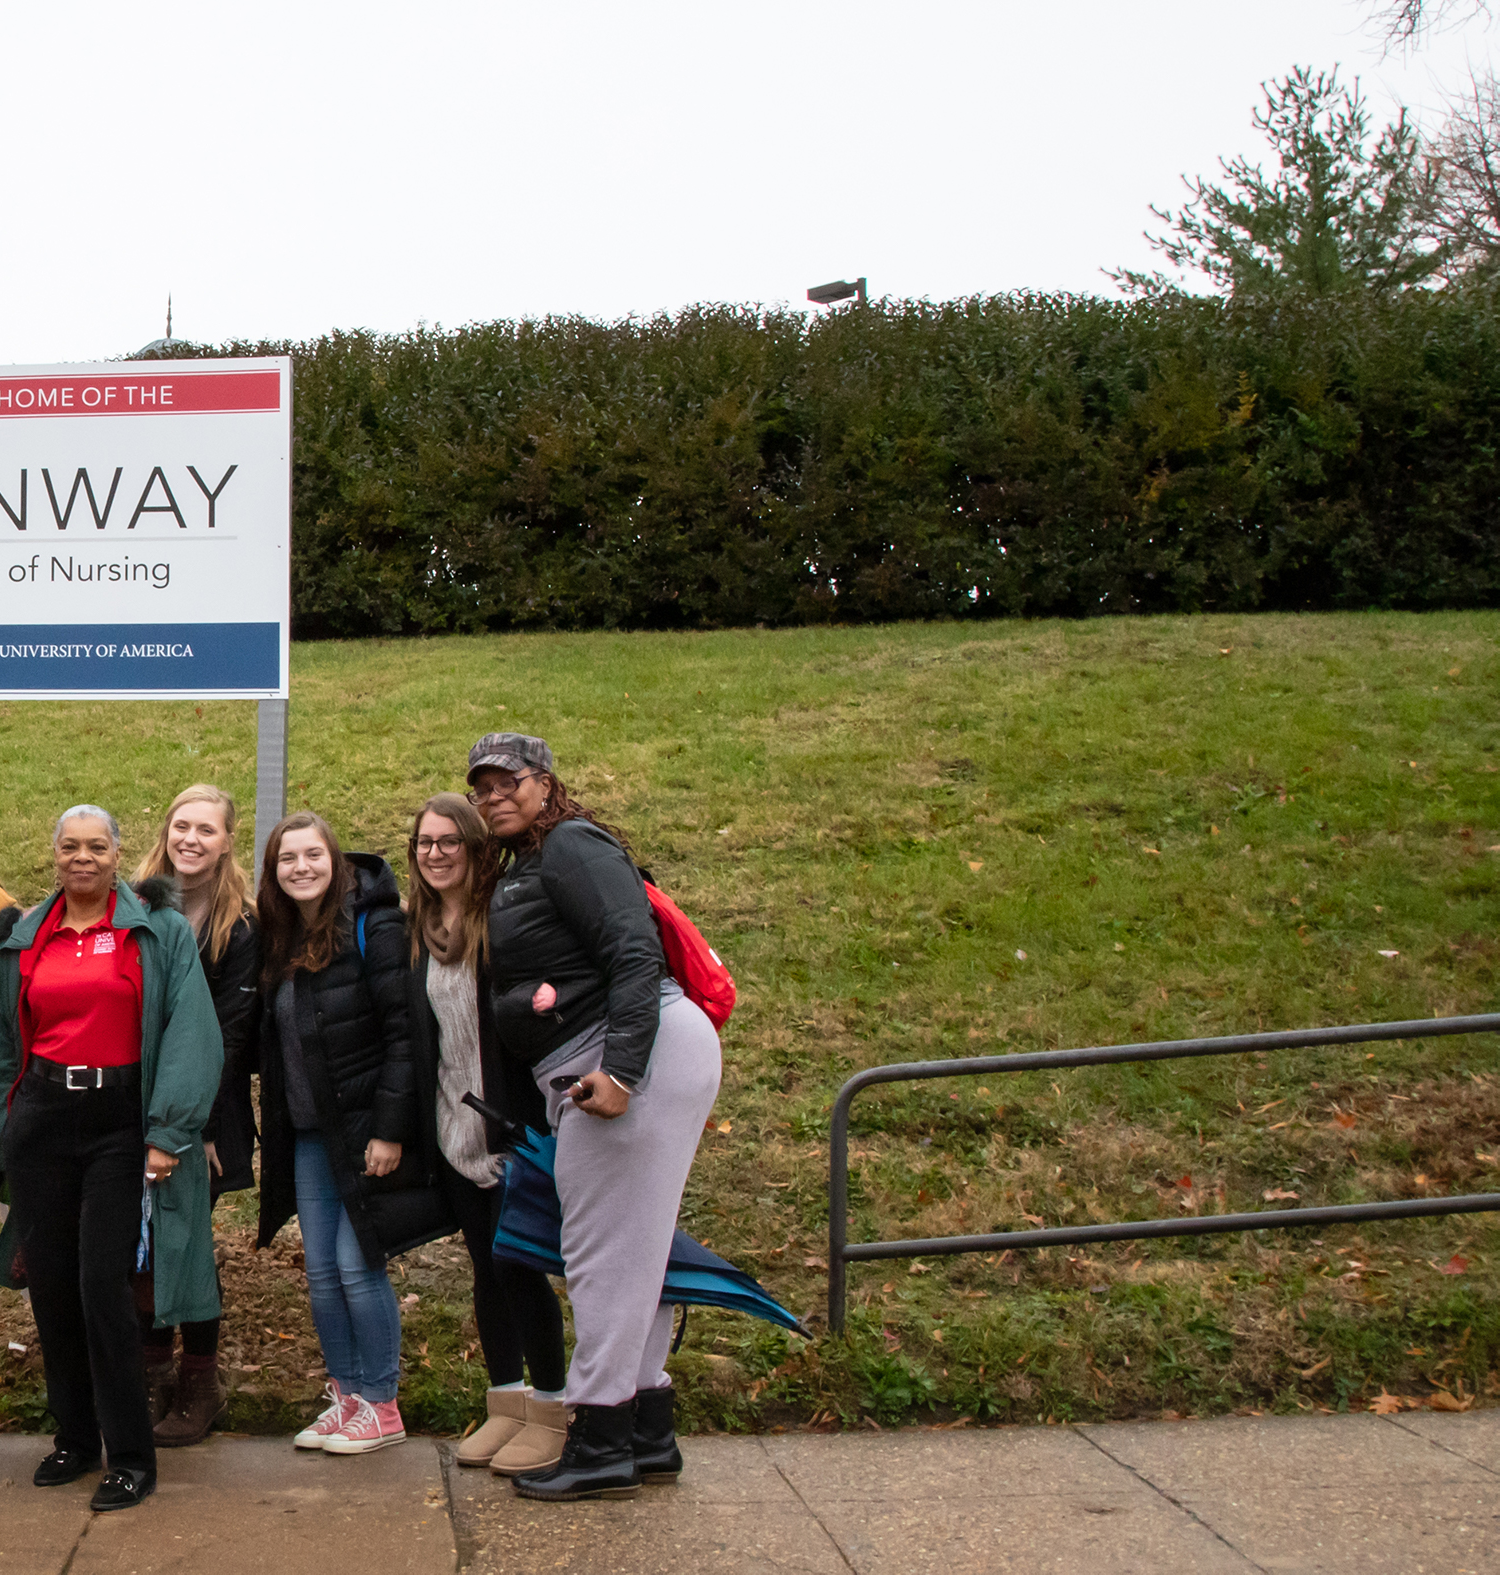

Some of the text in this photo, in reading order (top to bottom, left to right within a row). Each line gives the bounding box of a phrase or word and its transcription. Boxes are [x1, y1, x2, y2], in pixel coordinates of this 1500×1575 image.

[81, 386, 117, 406] OF
[123, 385, 174, 405] THE
[8, 554, 40, 582] of
[50, 556, 171, 589] Nursing
[0, 644, 93, 658] UNIVERSITY
[95, 643, 117, 657] OF
[119, 643, 194, 657] AMERICA
